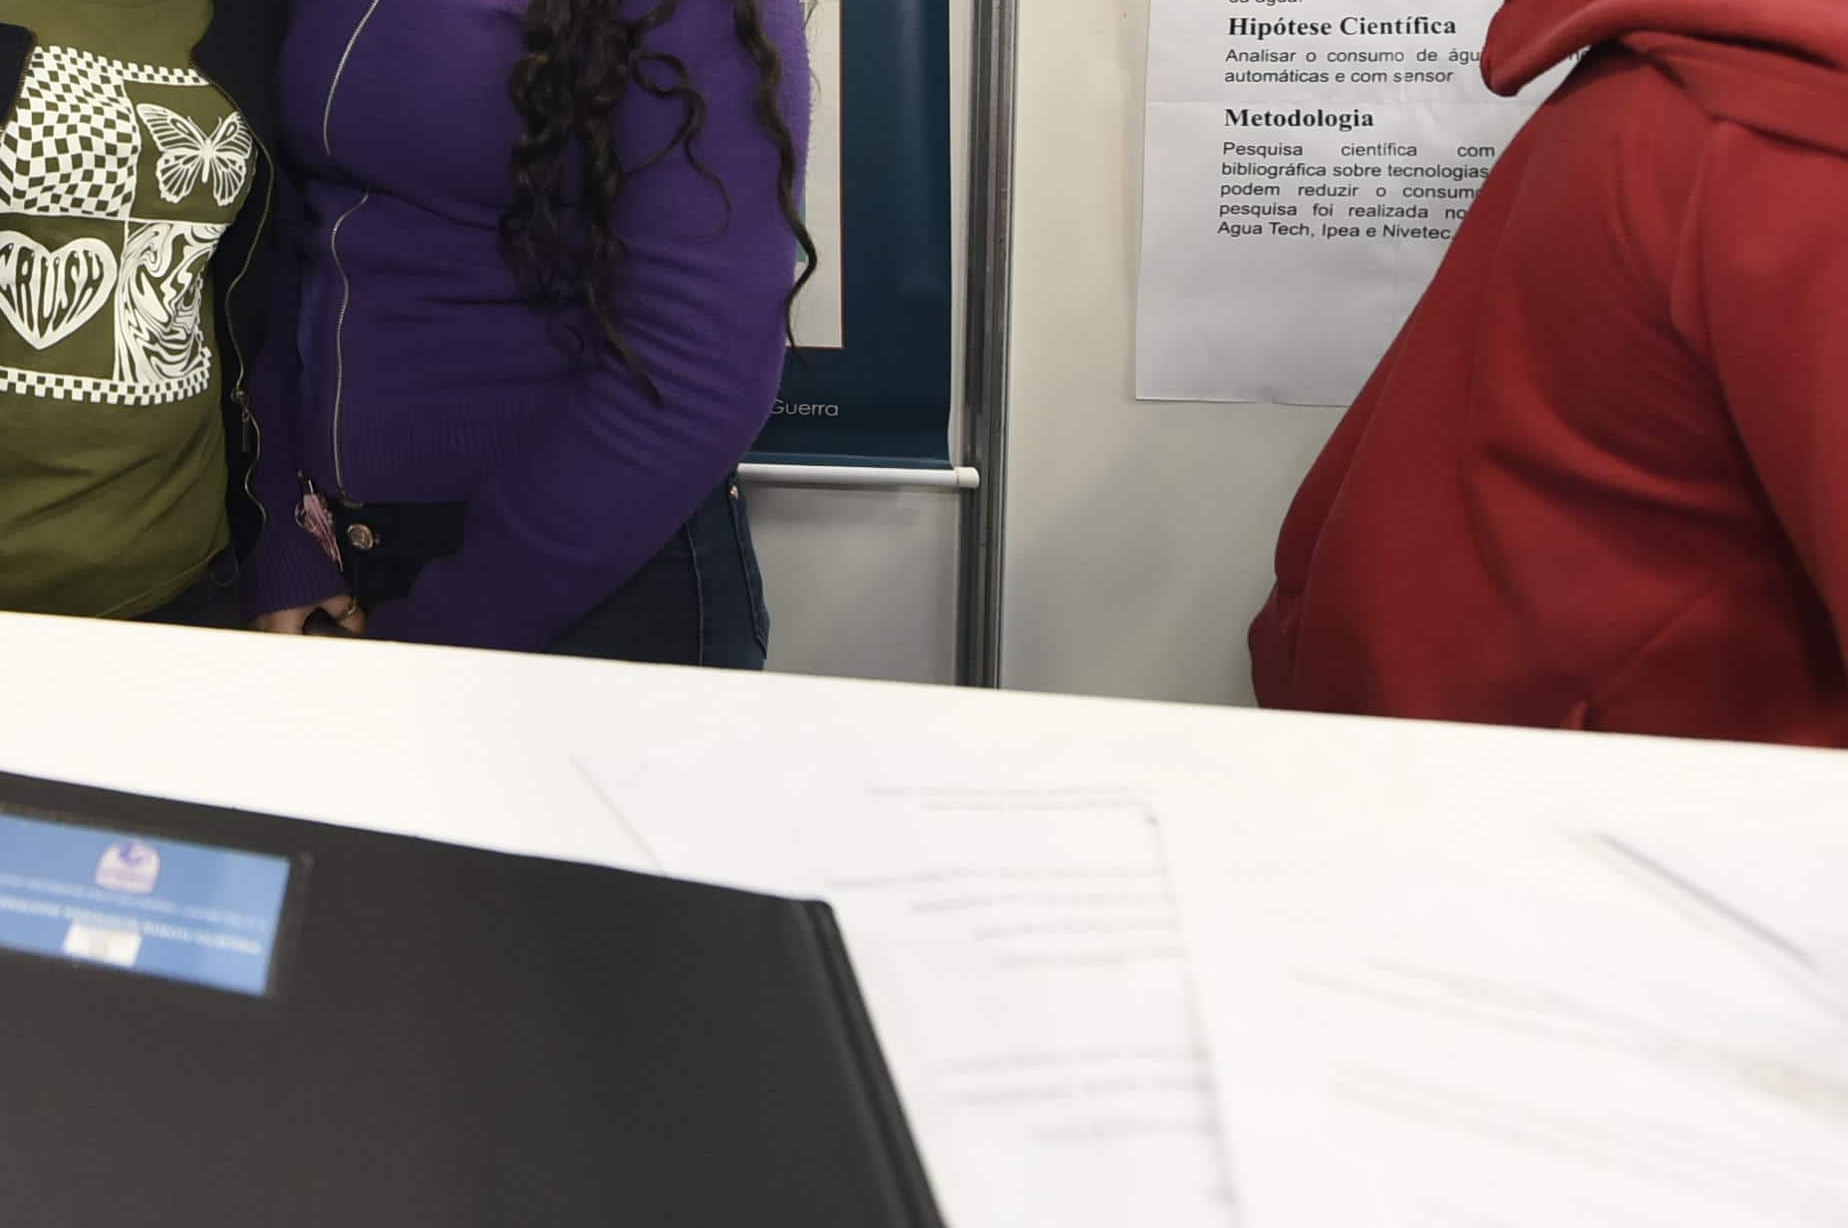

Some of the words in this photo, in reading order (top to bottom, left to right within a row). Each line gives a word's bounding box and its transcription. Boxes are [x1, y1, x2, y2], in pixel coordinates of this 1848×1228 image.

[1229, 17, 1332, 40] Hipótese
[1340, 16, 1456, 35] Científica
[1225, 69, 1329, 82] automáticas
[1335, 72, 1345, 83] e
[1351, 72, 1387, 82] com
[1393, 72, 1454, 83] sensor
[1224, 109, 1374, 132] Metodologia
[1223, 142, 1303, 158] Pesquisa
[1341, 143, 1417, 156] científica
[1457, 146, 1495, 157] com
[1222, 162, 1326, 179] bibliográfica
[1333, 164, 1381, 177] sobre
[1388, 164, 1489, 181] tecnologias
[771, 398, 839, 416] Guerra
